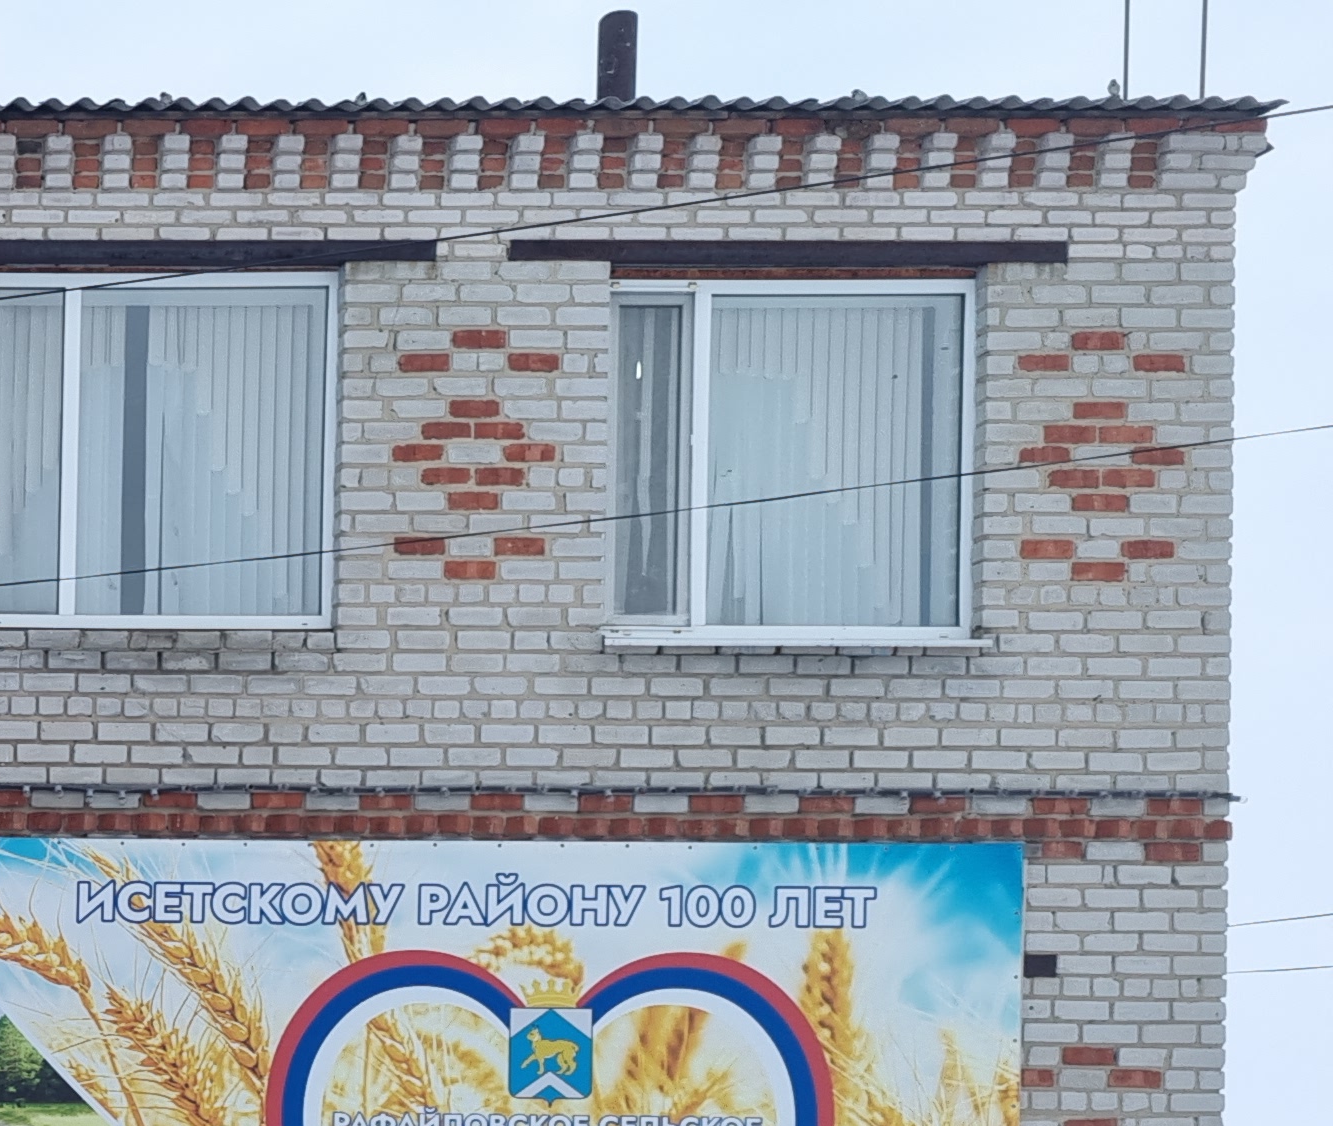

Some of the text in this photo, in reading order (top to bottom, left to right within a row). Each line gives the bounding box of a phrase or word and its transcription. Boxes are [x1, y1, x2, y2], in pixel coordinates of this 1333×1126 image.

[75, 872, 877, 930] ИСЕТСКОМУ РАЙОНУ 100 ЛЕТ
